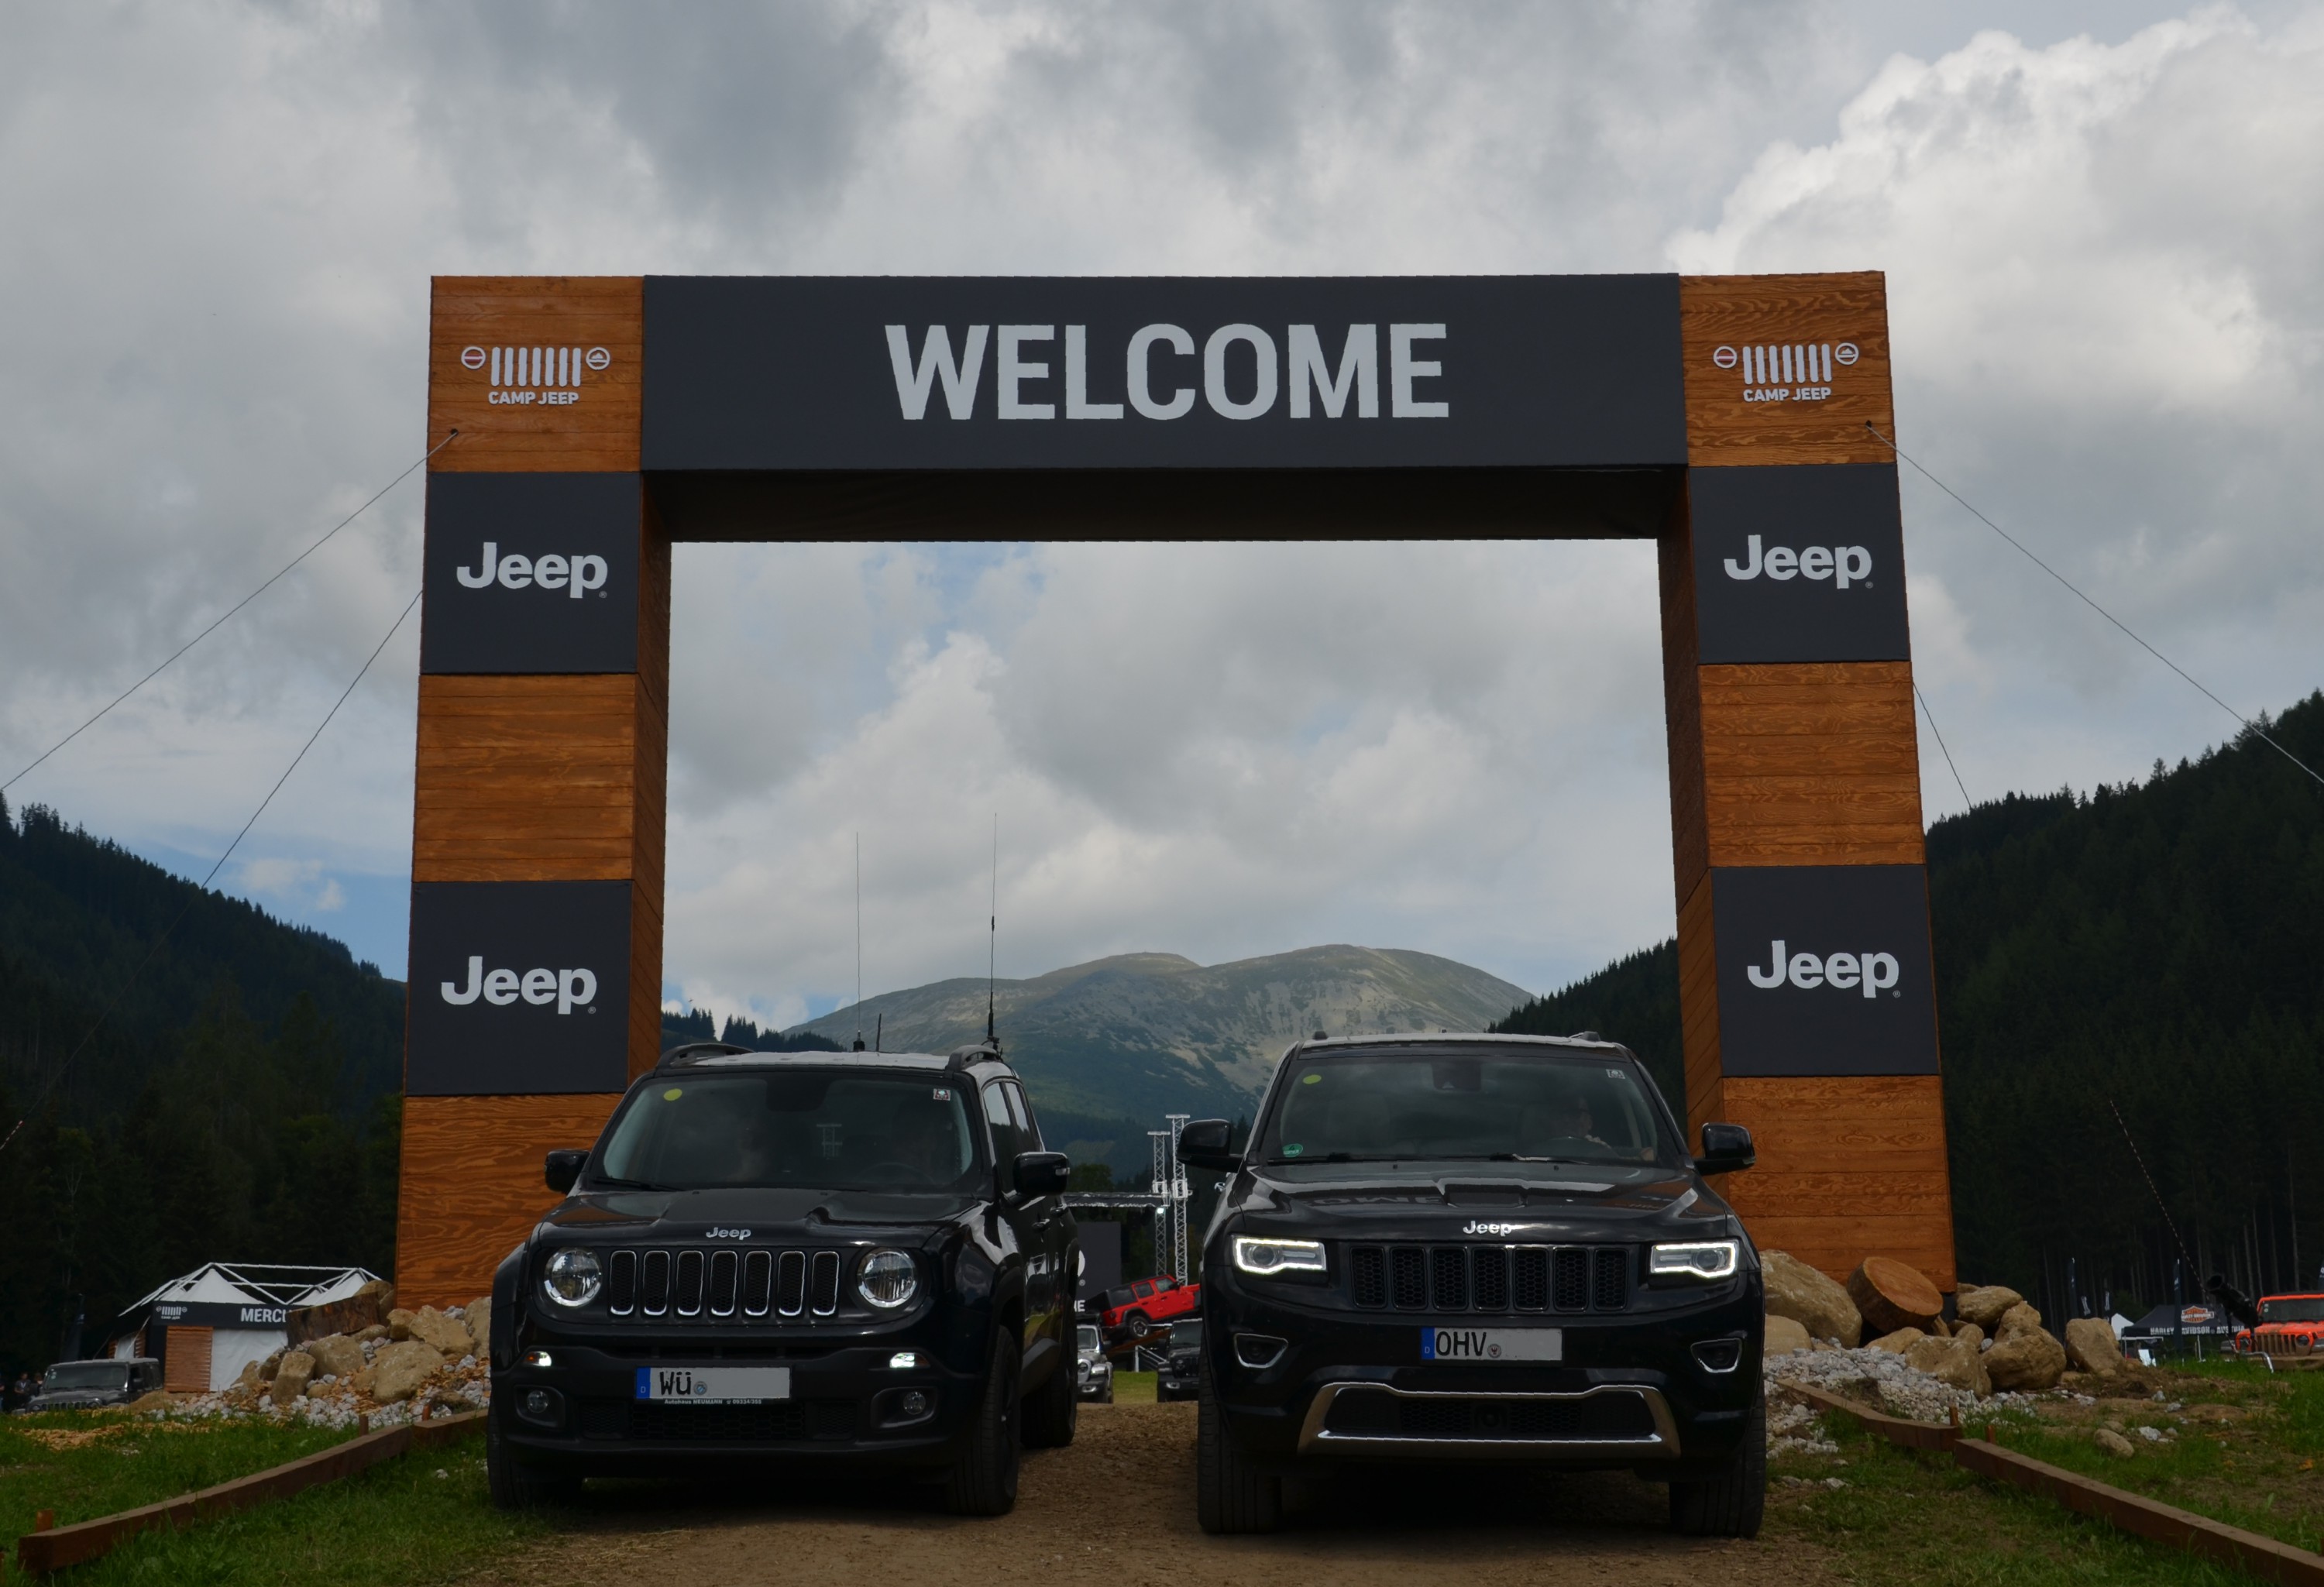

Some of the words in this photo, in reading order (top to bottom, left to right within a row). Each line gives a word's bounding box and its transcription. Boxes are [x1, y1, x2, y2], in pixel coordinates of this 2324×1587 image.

[884, 323, 1449, 421] WELCOME
[488, 391, 536, 405] CAMP
[537, 391, 579, 405] JEEP
[1743, 389, 1789, 402] CAMP
[1792, 387, 1832, 400] JEEP
[456, 541, 608, 599] Jeep
[1724, 534, 1872, 589] Jeep
[1747, 939, 1899, 998] Jeep
[441, 955, 597, 1015] Jeep
[706, 1227, 751, 1241] Jeep
[1463, 1220, 1512, 1237] Jeep
[1424, 1346, 1431, 1355] D
[1435, 1331, 1487, 1356] OHV
[659, 1371, 692, 1396] WÜ
